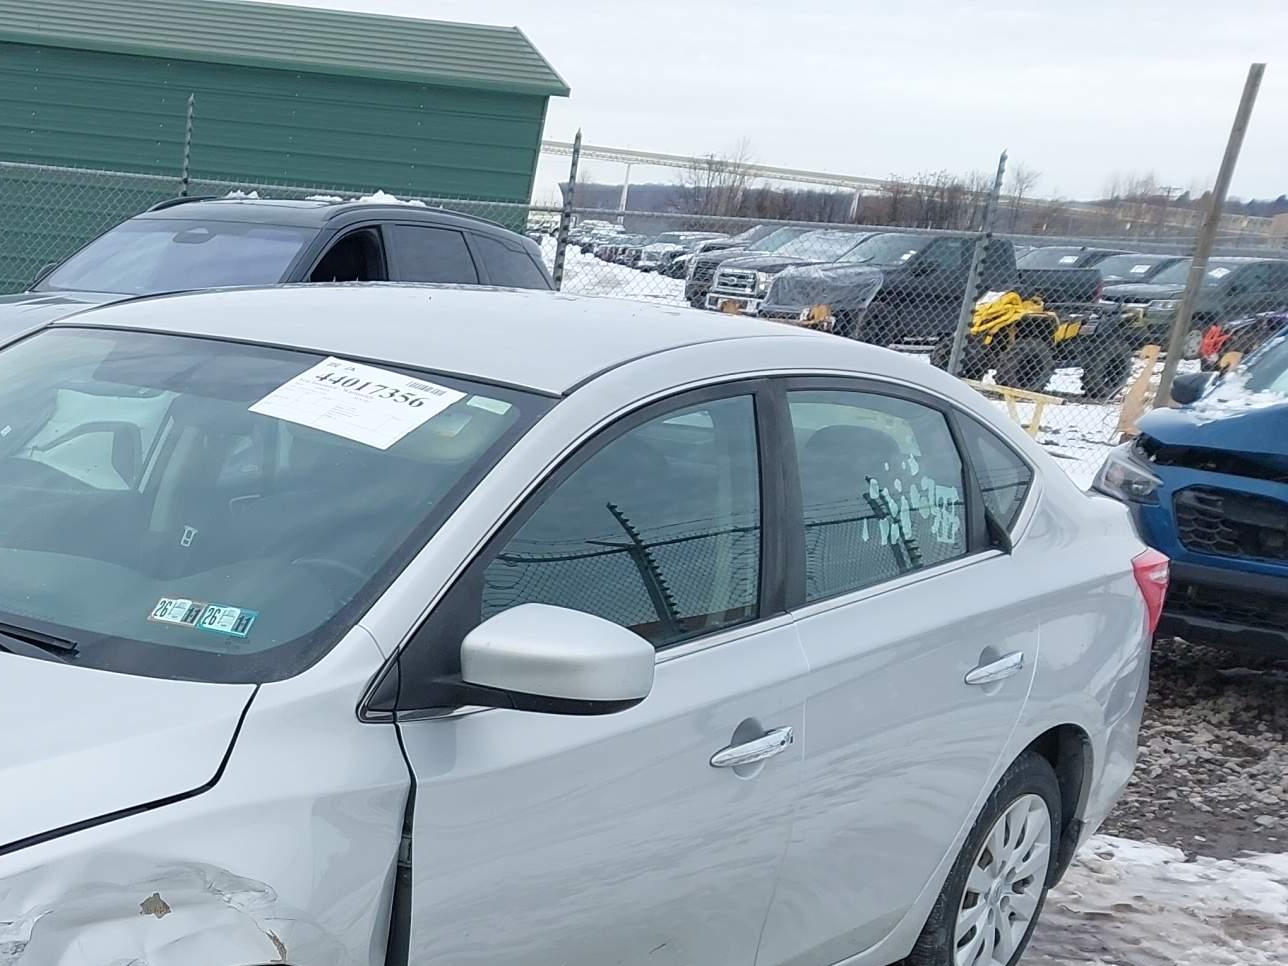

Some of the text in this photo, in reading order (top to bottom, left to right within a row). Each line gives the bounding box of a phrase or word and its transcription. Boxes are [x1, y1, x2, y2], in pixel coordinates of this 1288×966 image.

[315, 373, 429, 408] 44017356
[154, 600, 172, 618] 26
[202, 607, 222, 626] 26
[233, 614, 252, 633] 11
